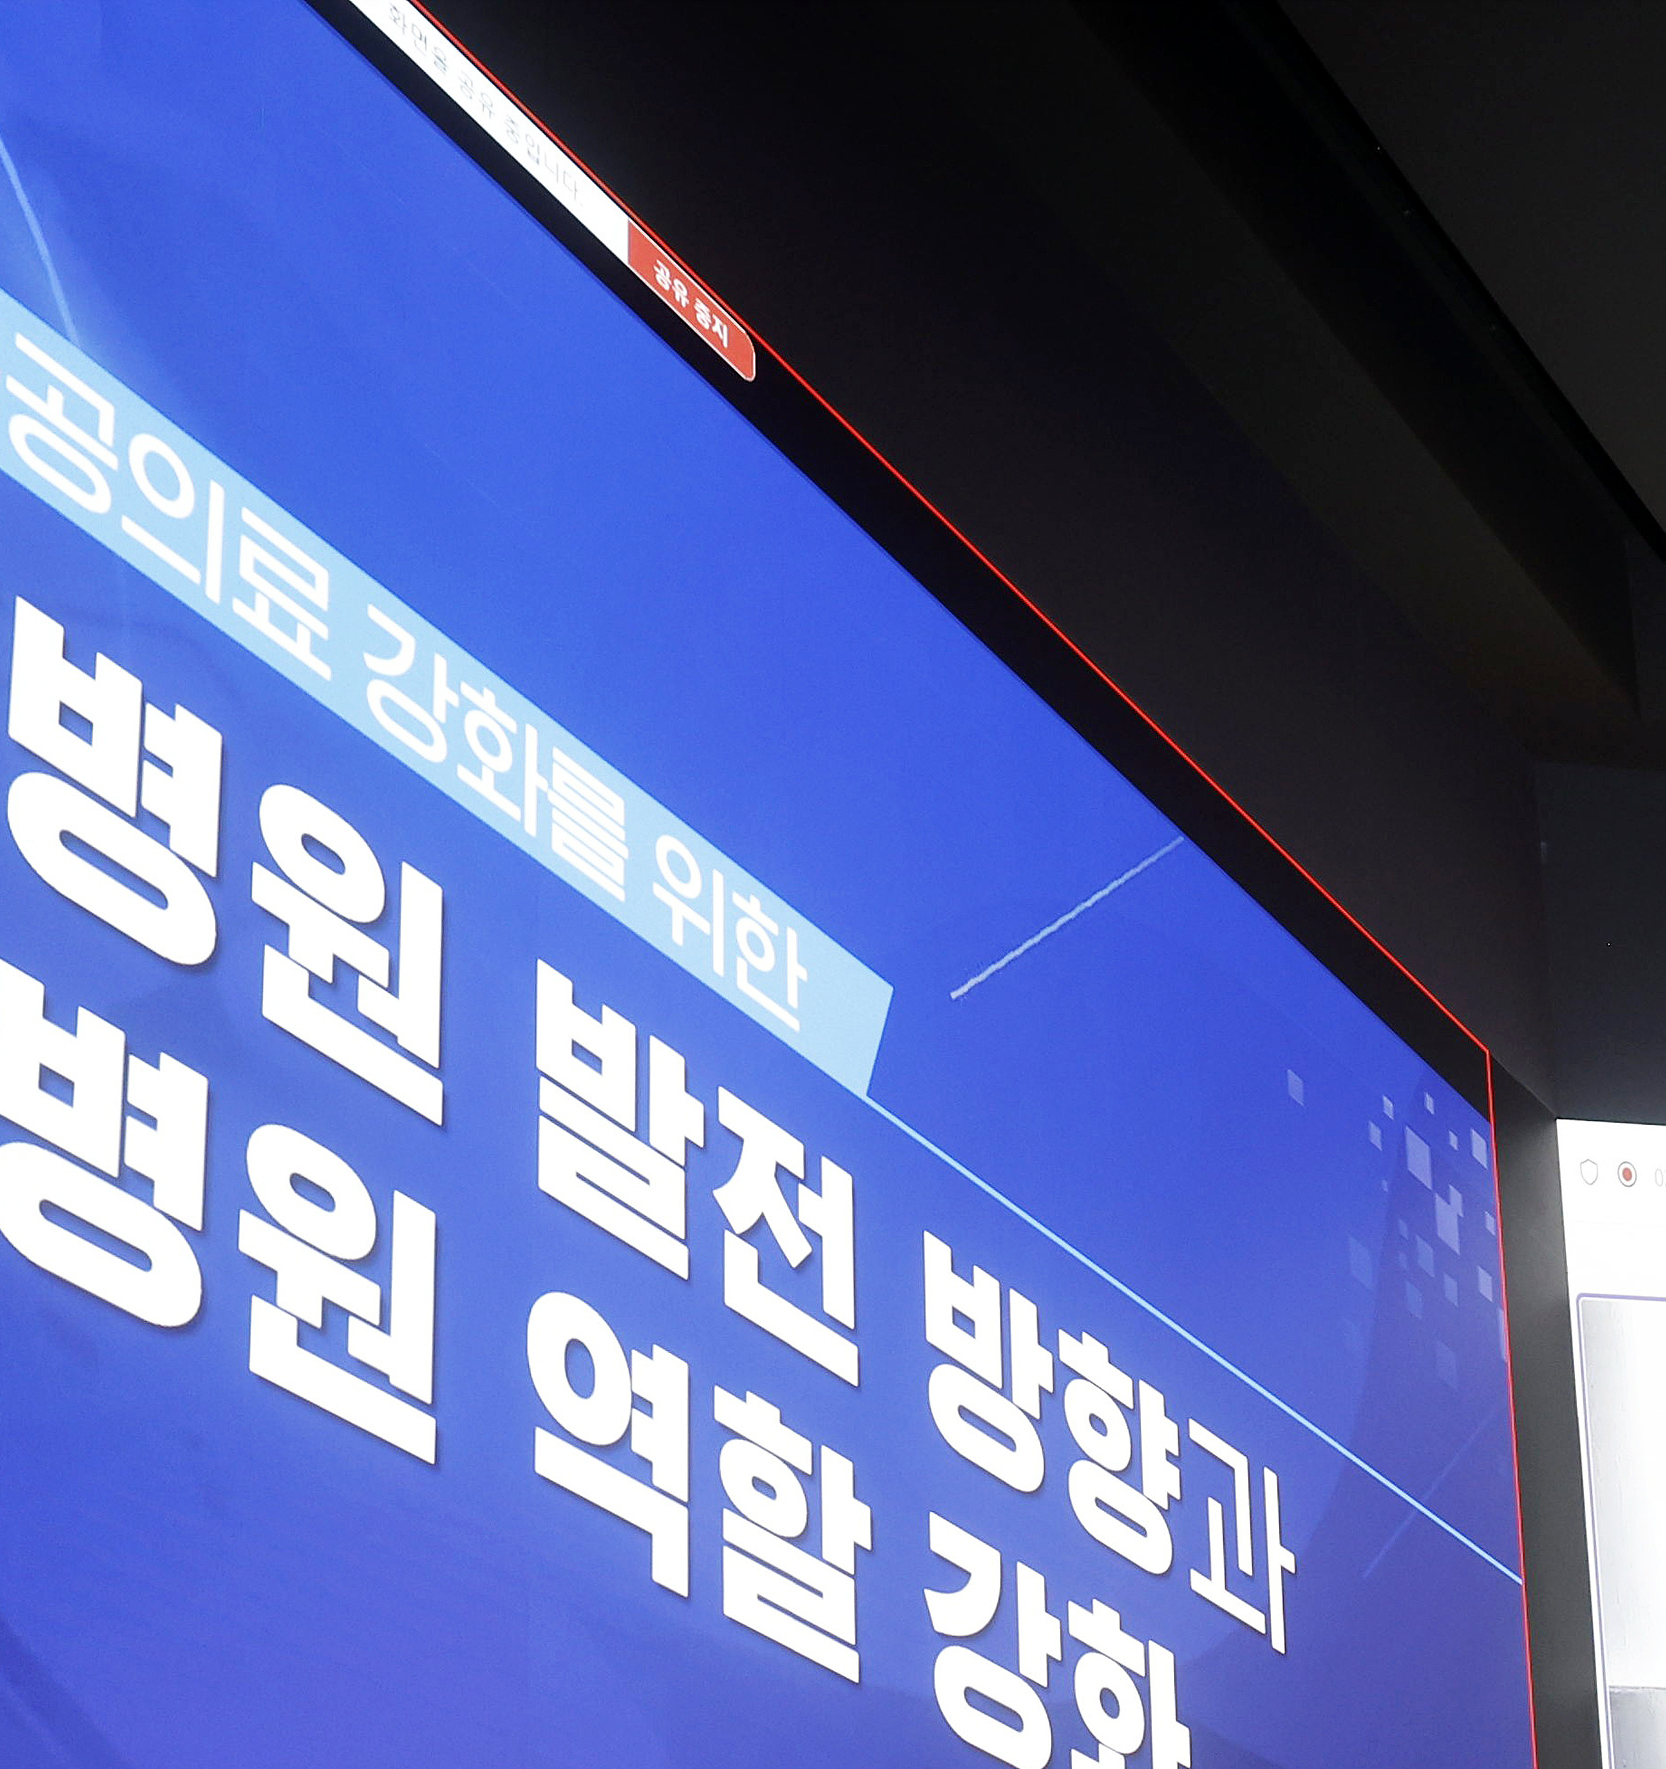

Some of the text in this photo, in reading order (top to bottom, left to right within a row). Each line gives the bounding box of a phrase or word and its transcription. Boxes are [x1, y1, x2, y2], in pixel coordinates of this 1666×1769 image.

[652, 259, 730, 349] 공유 중지
[363, 604, 627, 902] 강화를
[652, 833, 808, 1032] 위한
[526, 1290, 873, 1684] 역할
[537, 958, 860, 1388] 발전
[923, 1230, 1296, 1654] 방향과
